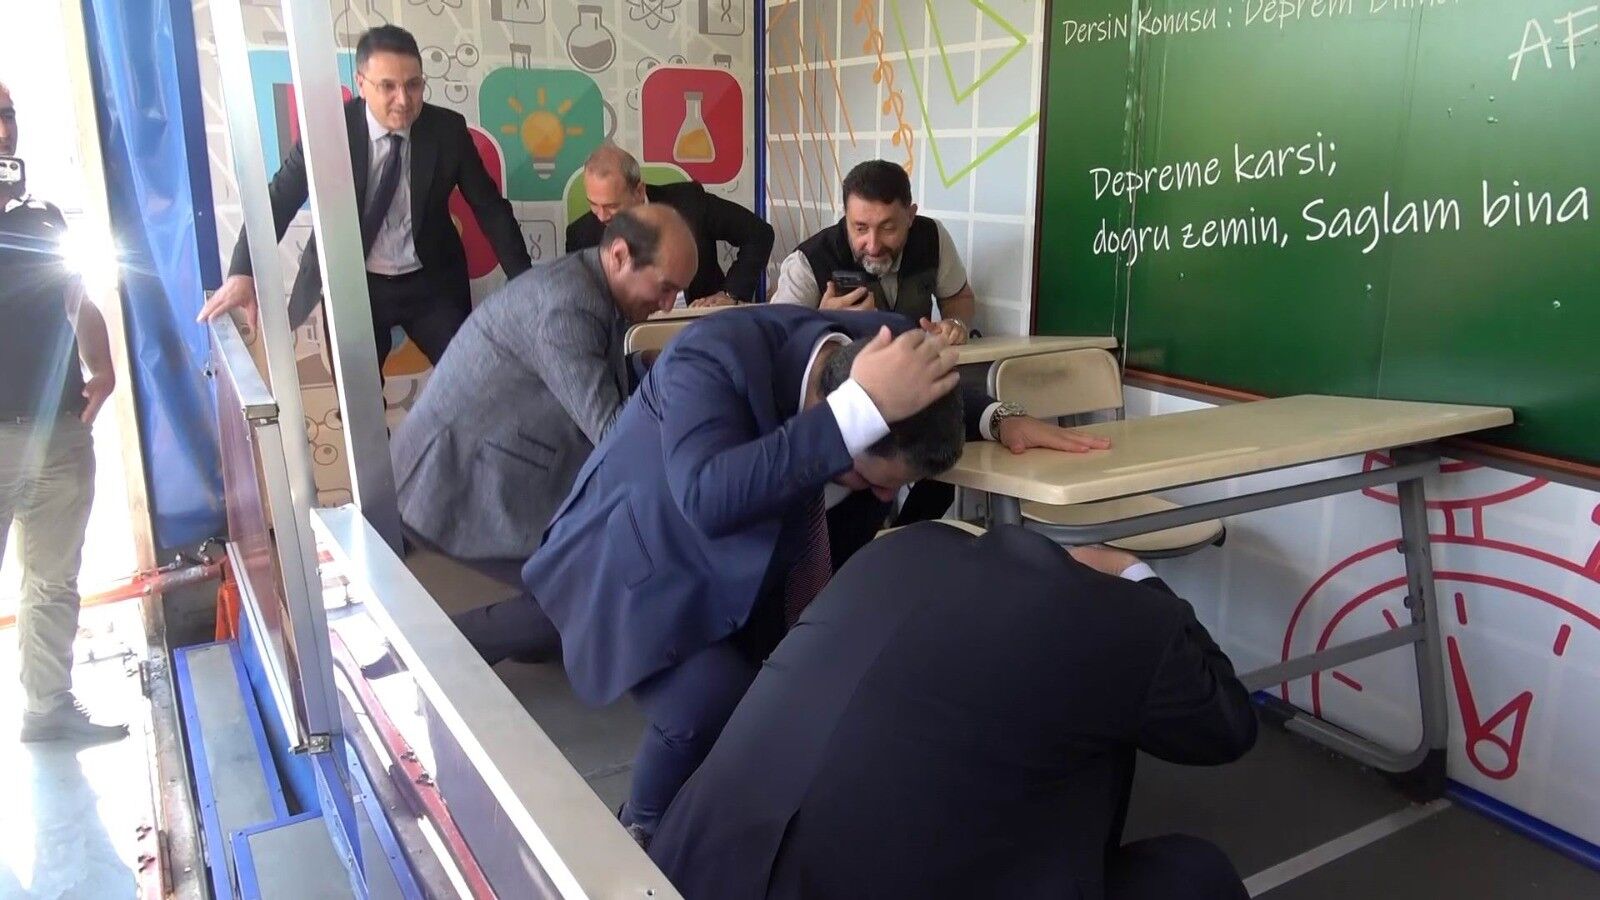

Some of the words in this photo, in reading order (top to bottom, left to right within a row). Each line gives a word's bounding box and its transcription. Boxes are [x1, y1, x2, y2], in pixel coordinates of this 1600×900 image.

[1137, 6, 1217, 36] Konusu
[1507, 5, 1599, 81] AF
[1089, 157, 1222, 203] Depreme
[1234, 131, 1337, 183] karsi;
[1092, 217, 1171, 267] dogru
[1180, 206, 1289, 248] zemin,
[1302, 190, 1461, 254] Saglam
[1482, 179, 1590, 228] bina
